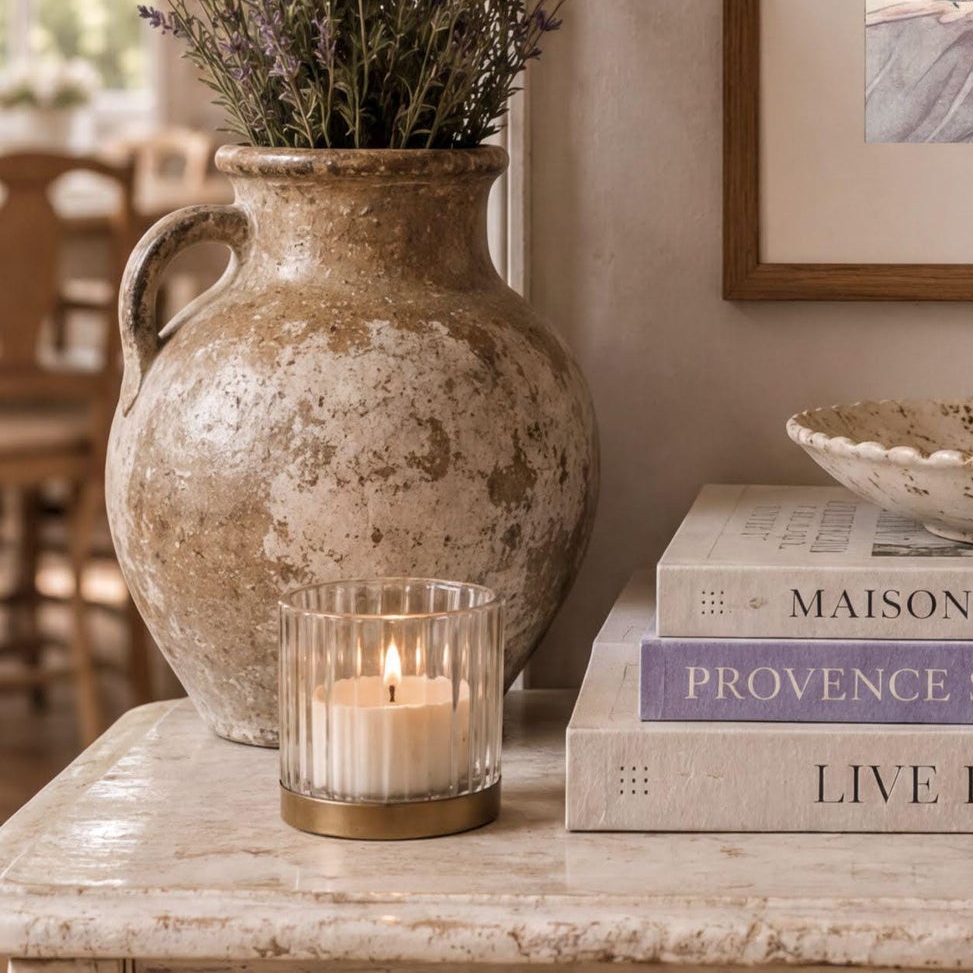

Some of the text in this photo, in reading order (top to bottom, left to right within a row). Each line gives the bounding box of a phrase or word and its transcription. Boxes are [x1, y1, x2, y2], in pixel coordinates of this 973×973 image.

[790, 588, 971, 620] MAISON
[685, 666, 950, 702] PROVENCE
[815, 764, 939, 805] LIVE
